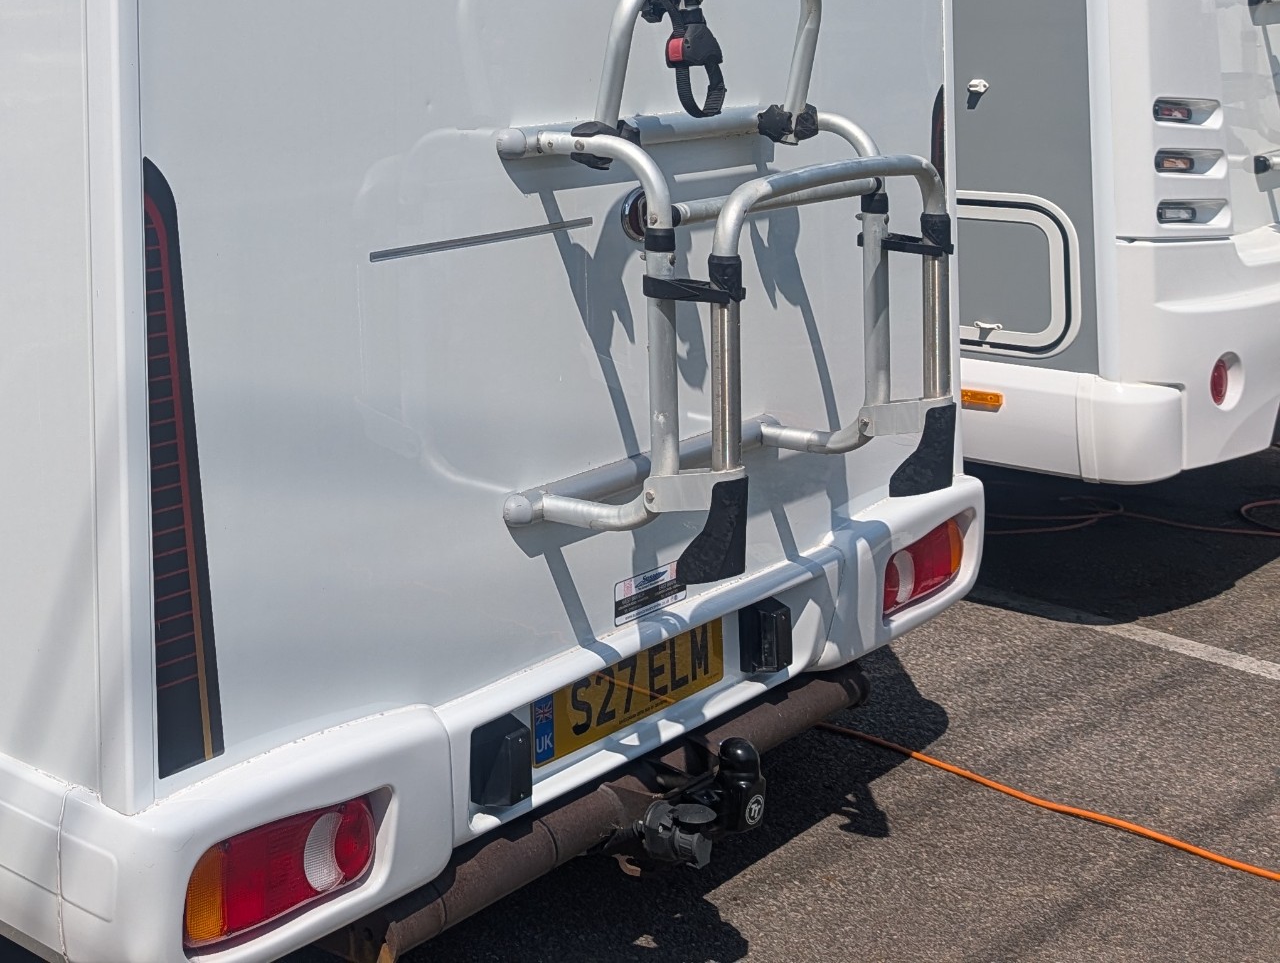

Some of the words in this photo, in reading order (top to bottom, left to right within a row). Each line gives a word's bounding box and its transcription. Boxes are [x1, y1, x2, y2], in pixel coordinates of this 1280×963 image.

[572, 654, 637, 735] S27
[649, 623, 709, 702] ELM
[536, 733, 553, 753] UK
